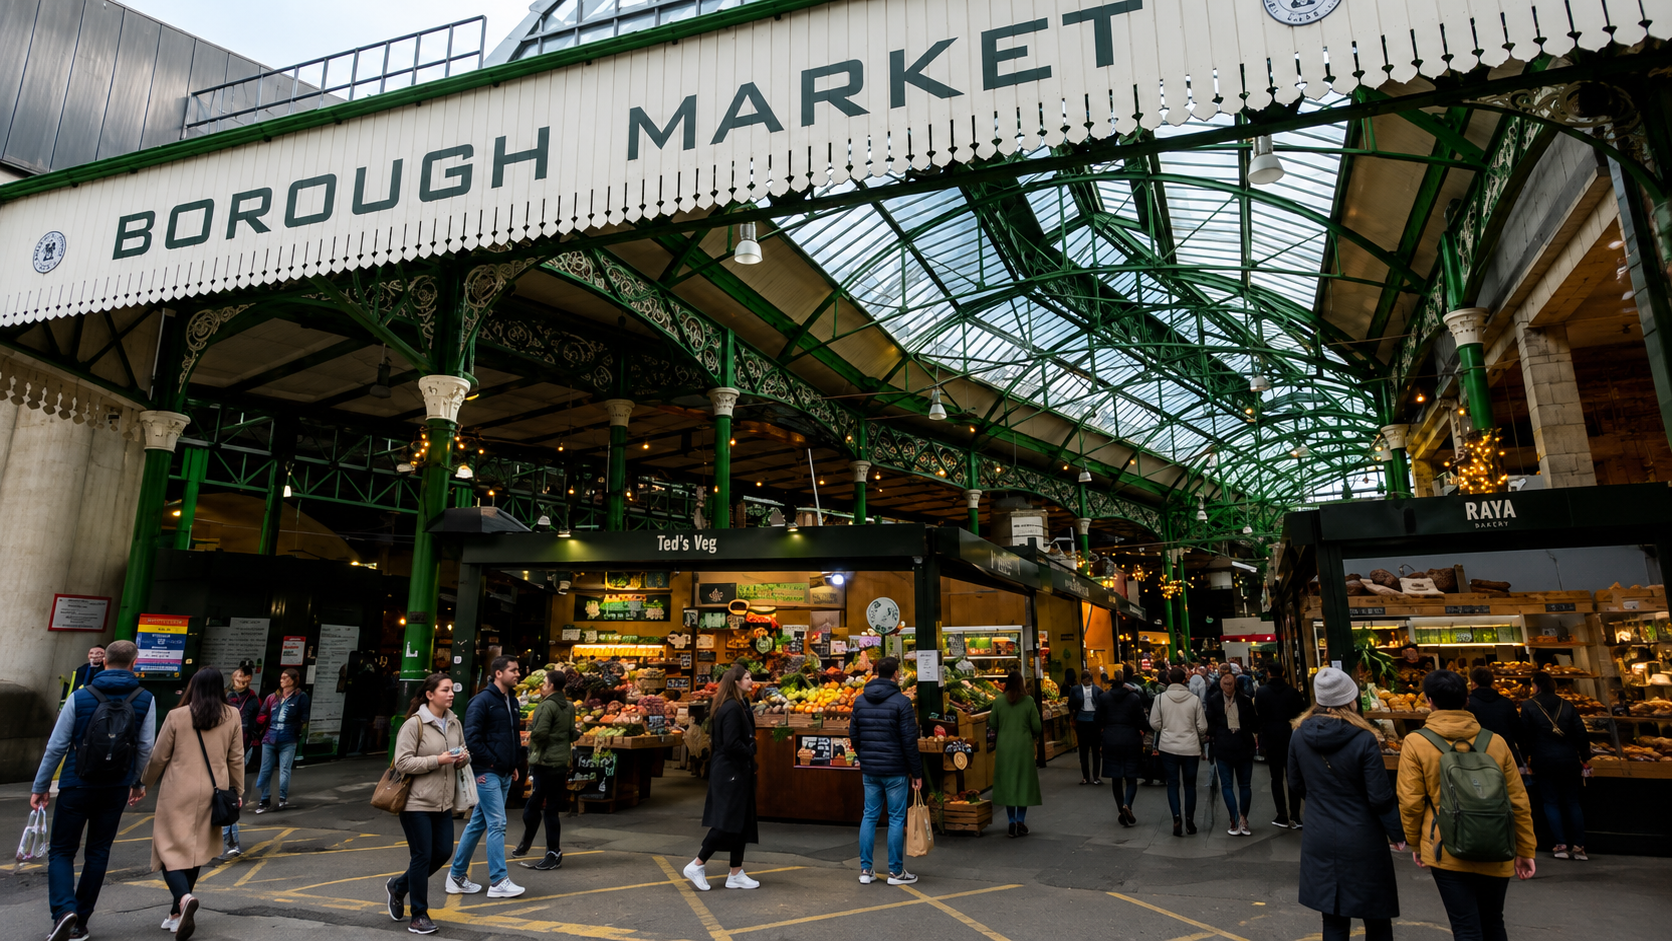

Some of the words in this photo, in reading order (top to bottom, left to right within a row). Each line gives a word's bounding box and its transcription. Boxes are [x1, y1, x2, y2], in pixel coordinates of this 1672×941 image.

[113, 126, 550, 260] BOROUGH
[628, 0, 1144, 161] MARKET
[1465, 499, 1517, 520] RAYA
[657, 534, 690, 551] Ted's
[694, 534, 717, 554] Veg
